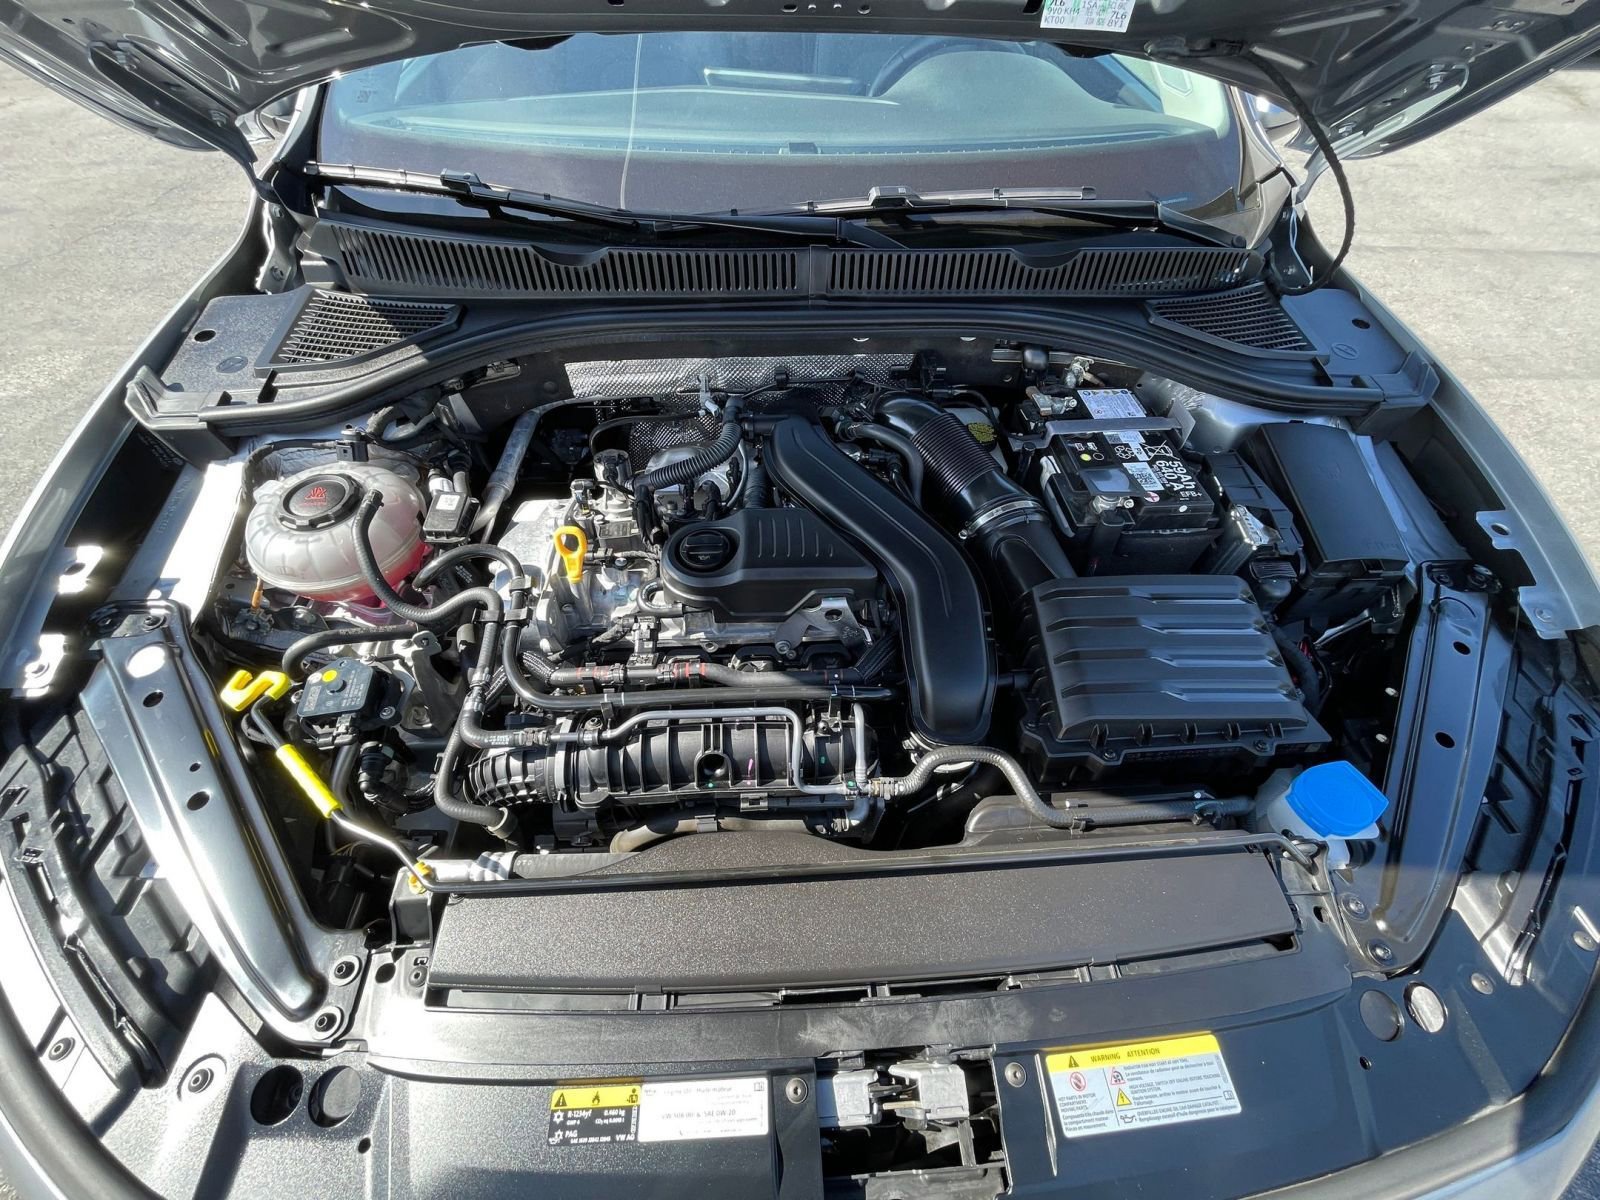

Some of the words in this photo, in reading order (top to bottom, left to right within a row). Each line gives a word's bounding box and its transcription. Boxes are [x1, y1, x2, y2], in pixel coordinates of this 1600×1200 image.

[1110, 10, 1127, 19] 7L6
[1156, 460, 1177, 479] 640
[1169, 482, 1184, 491] A
[1169, 461, 1196, 488] 59Ah
[1090, 1052, 1121, 1063] WARNING
[1126, 1047, 1161, 1058] ATTENTION
[568, 1109, 592, 1119] R-1234yf
